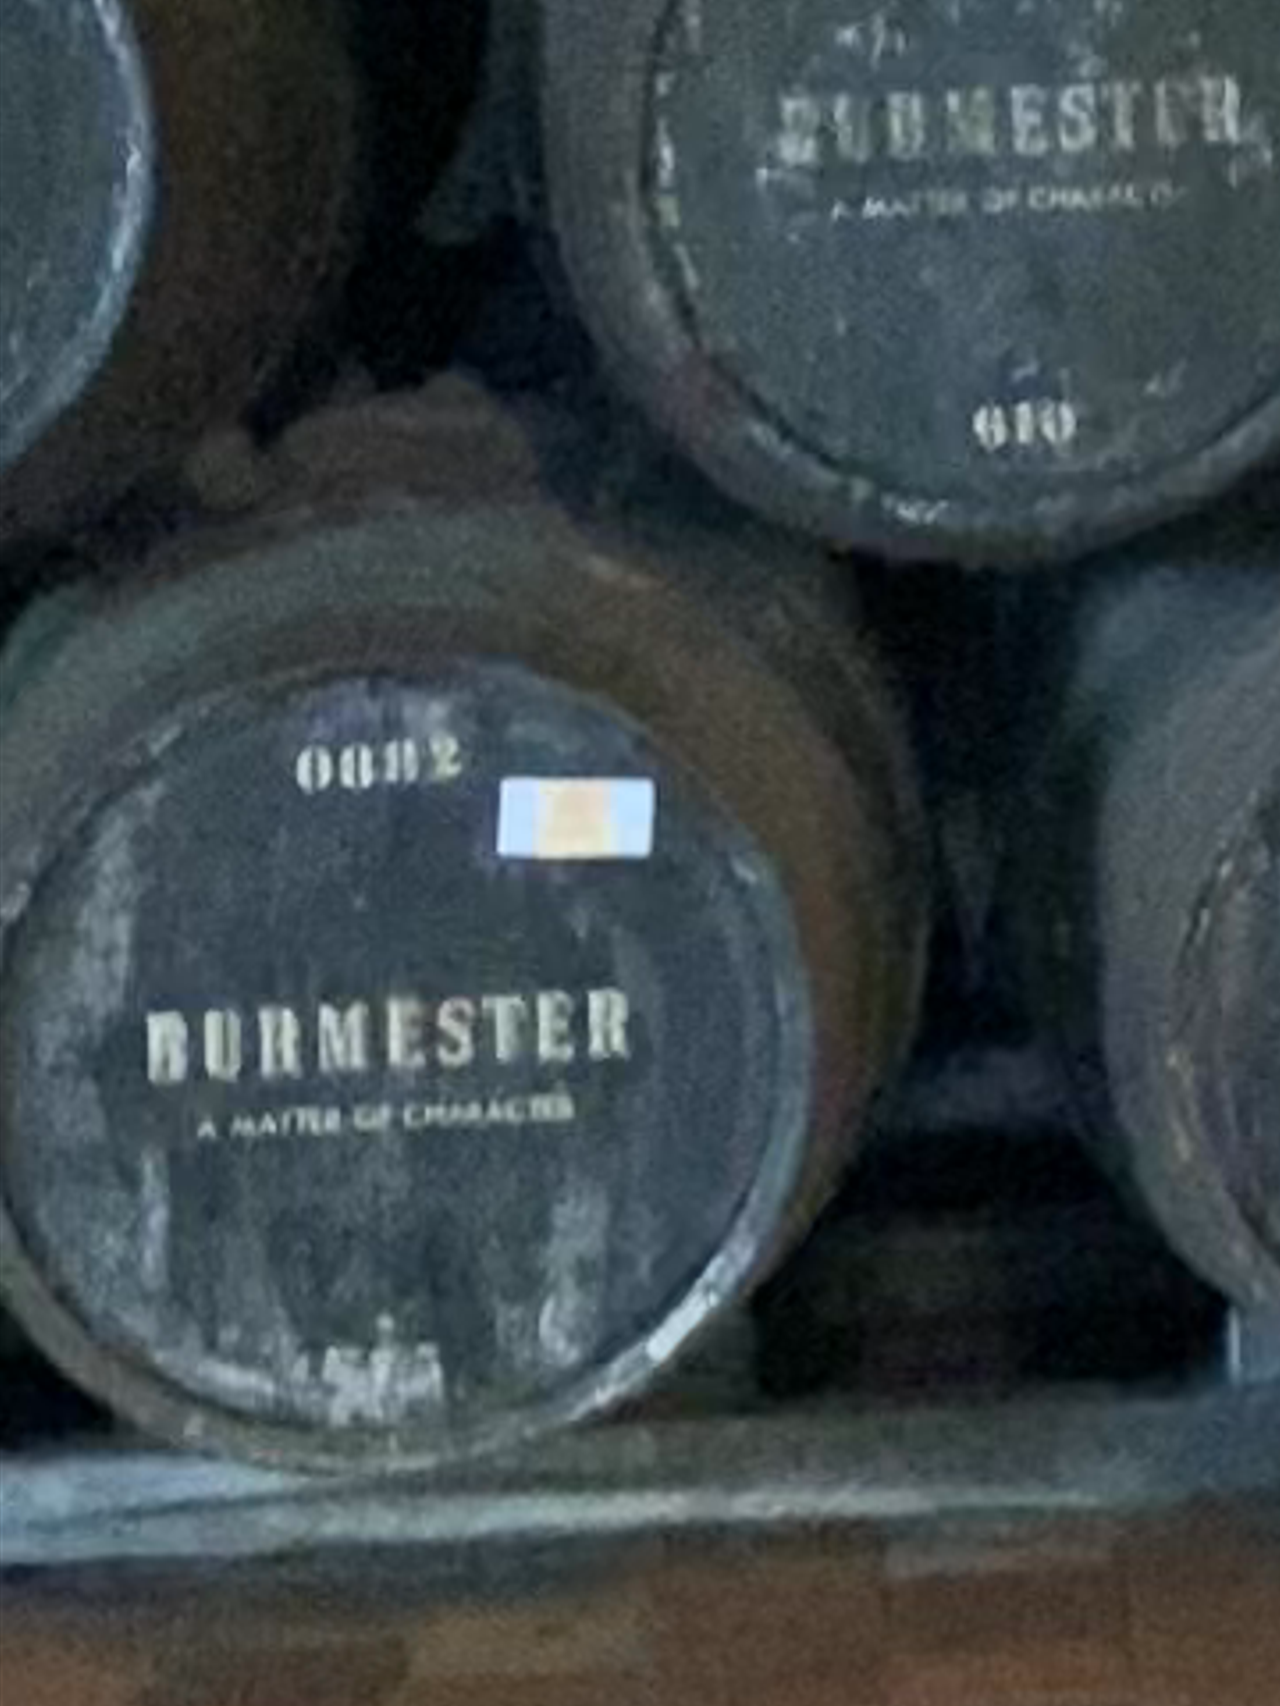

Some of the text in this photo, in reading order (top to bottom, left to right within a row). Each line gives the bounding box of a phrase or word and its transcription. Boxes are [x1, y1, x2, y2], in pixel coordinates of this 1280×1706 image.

[144, 986, 630, 1085] BURMESTER
[198, 1092, 577, 1140] A MATTER OF CHARACTER
